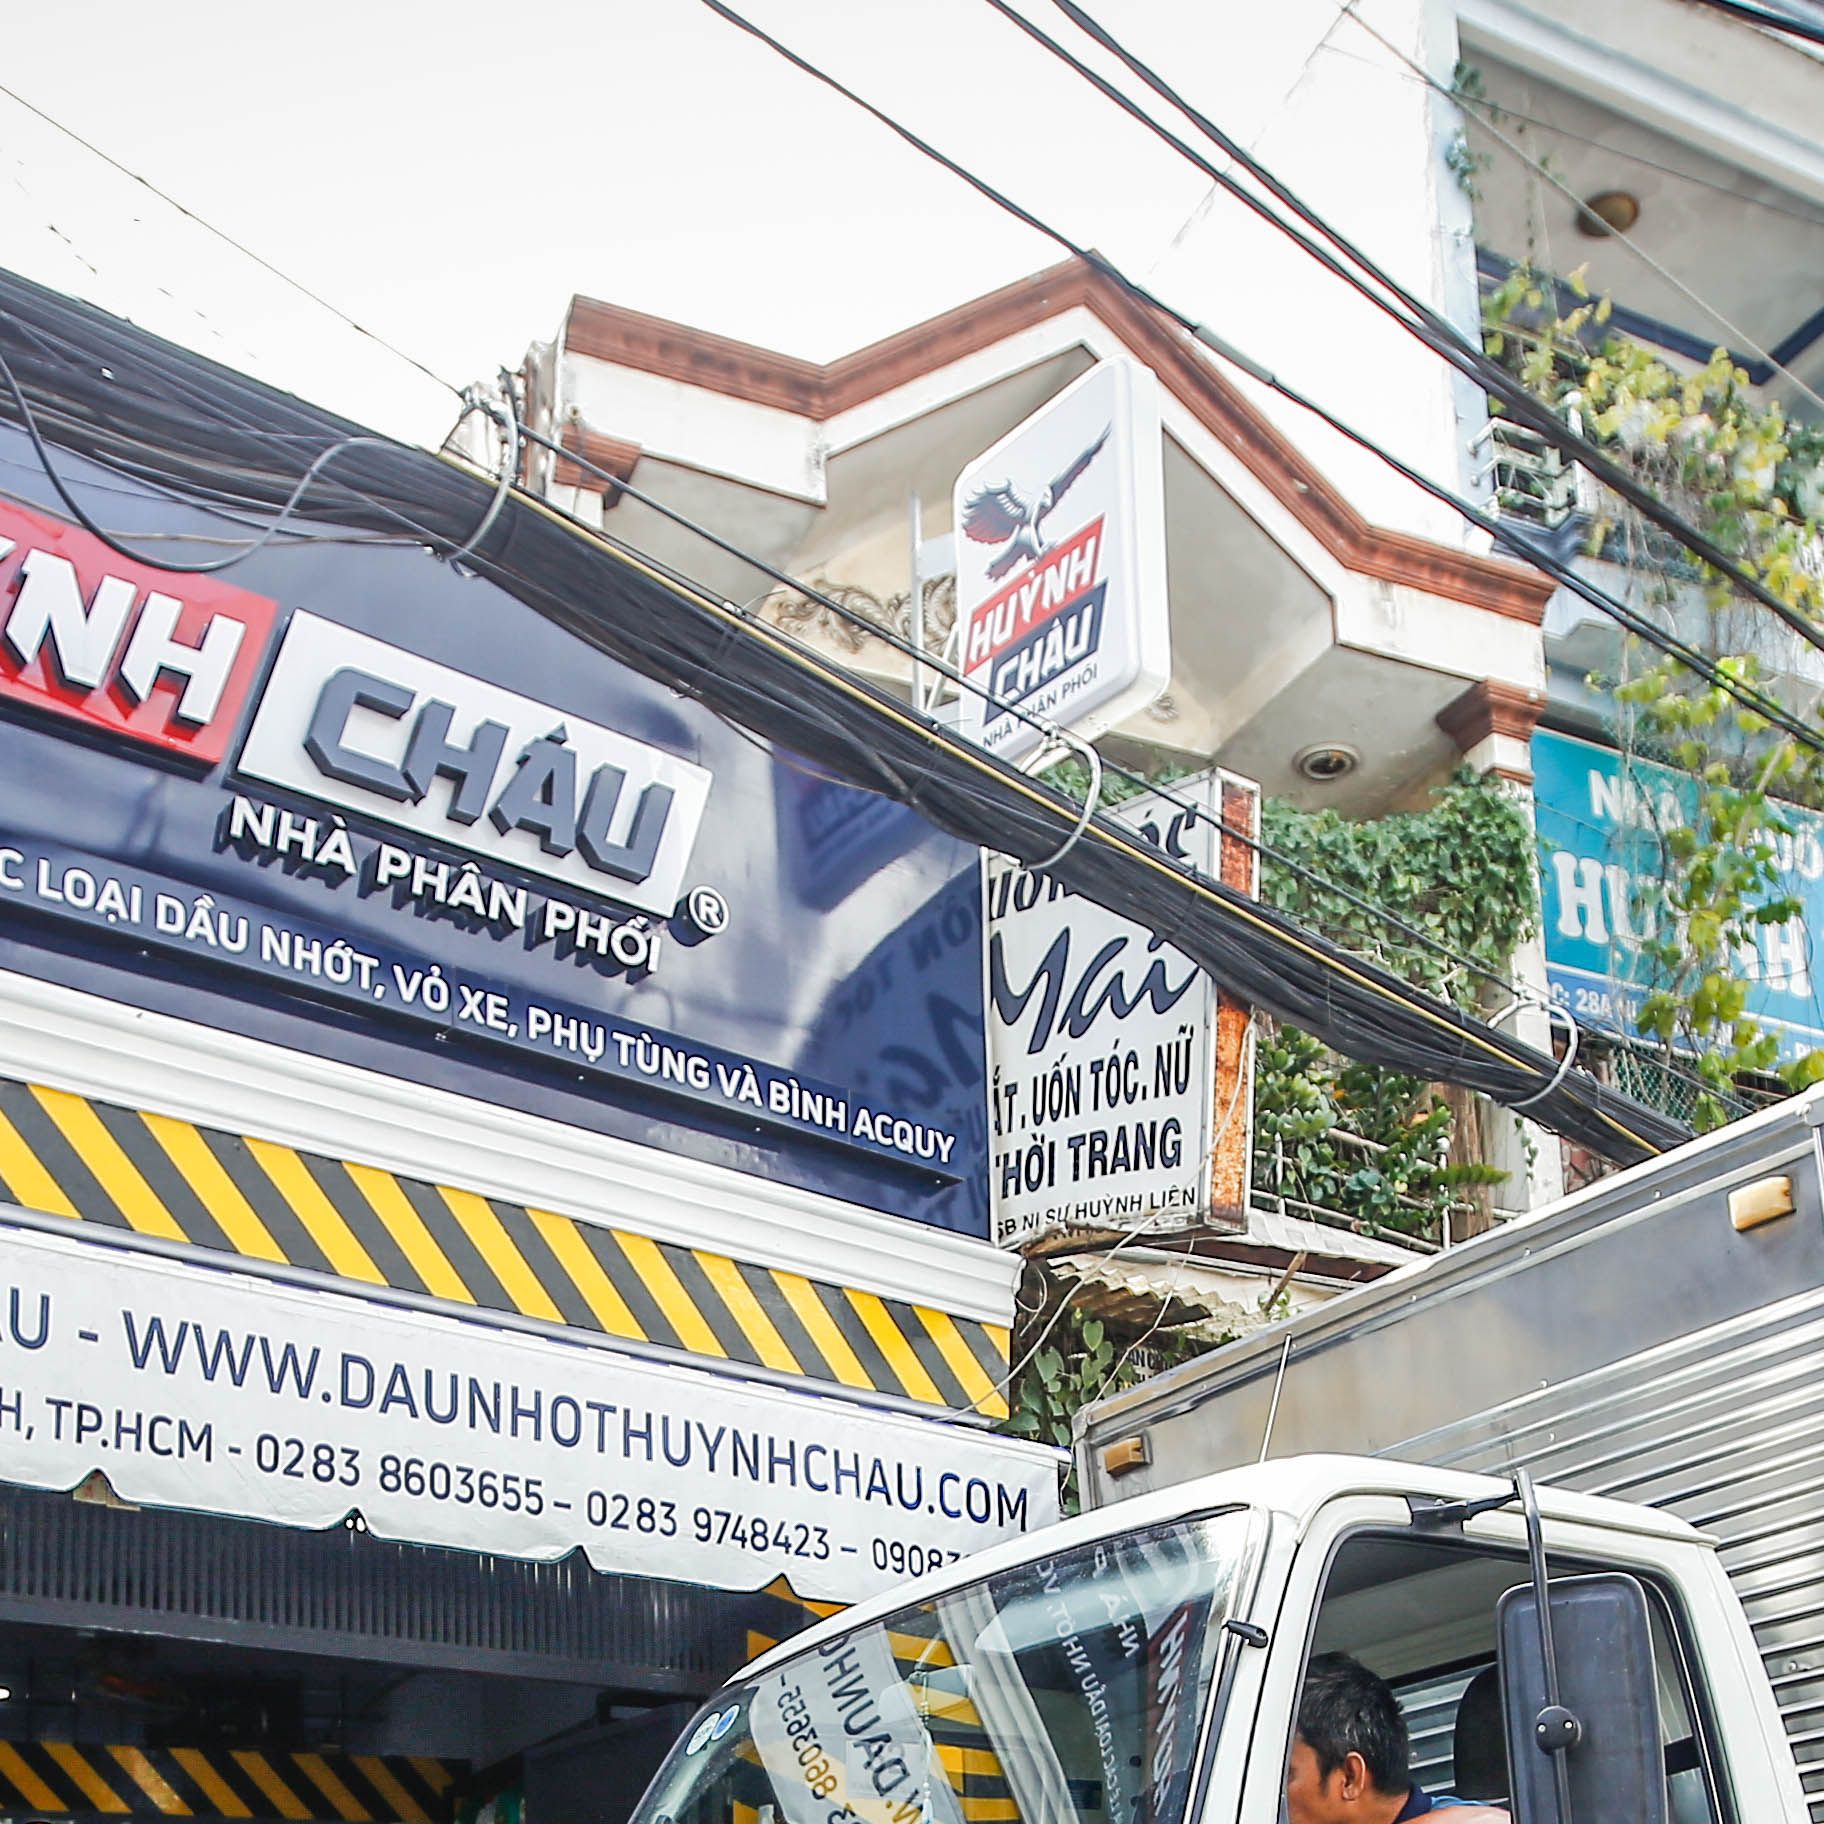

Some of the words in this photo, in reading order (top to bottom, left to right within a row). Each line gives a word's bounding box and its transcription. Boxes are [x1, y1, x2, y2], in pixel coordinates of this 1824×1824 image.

[969, 541, 1100, 662] HUỲNH
[995, 604, 1095, 699] CHÂU
[1063, 662, 1097, 700] PHỐI
[303, 665, 675, 884] CHÂU
[230, 794, 358, 875] NHÀ
[376, 843, 528, 928] PHÂN
[543, 897, 662, 974] PHỐI
[37, 858, 142, 925] LOẠI
[155, 893, 248, 955] DẦU
[260, 926, 385, 1000] NHỚT,
[393, 964, 450, 1015] VỎ
[460, 985, 519, 1039] XE,
[527, 1004, 604, 1062] PHỤ
[613, 1027, 710, 1090] TÙNG
[716, 1062, 762, 1108] VÀ
[769, 1075, 847, 1134] BÌNH
[853, 1109, 957, 1164] ACQUY
[1033, 1052, 1081, 1125] UỐN
[1154, 1025, 1194, 1099] NỮ
[995, 1132, 1056, 1198] HỜI
[1067, 1117, 1182, 1183] TRANG
[1022, 1212, 1039, 1230] NI
[1075, 1192, 1143, 1219] HUỲNH
[1150, 1184, 1196, 1211] LIÊN
[45, 1396, 213, 1464] TP.HCM
[255, 1433, 361, 1488] 0283
[379, 1454, 546, 1517] 8603655
[587, 1489, 678, 1537] 0283
[693, 1506, 831, 1561] 9748423
[122, 1310, 1029, 1533] WWW.DAUNHOTHUYNHCHAU.COM
